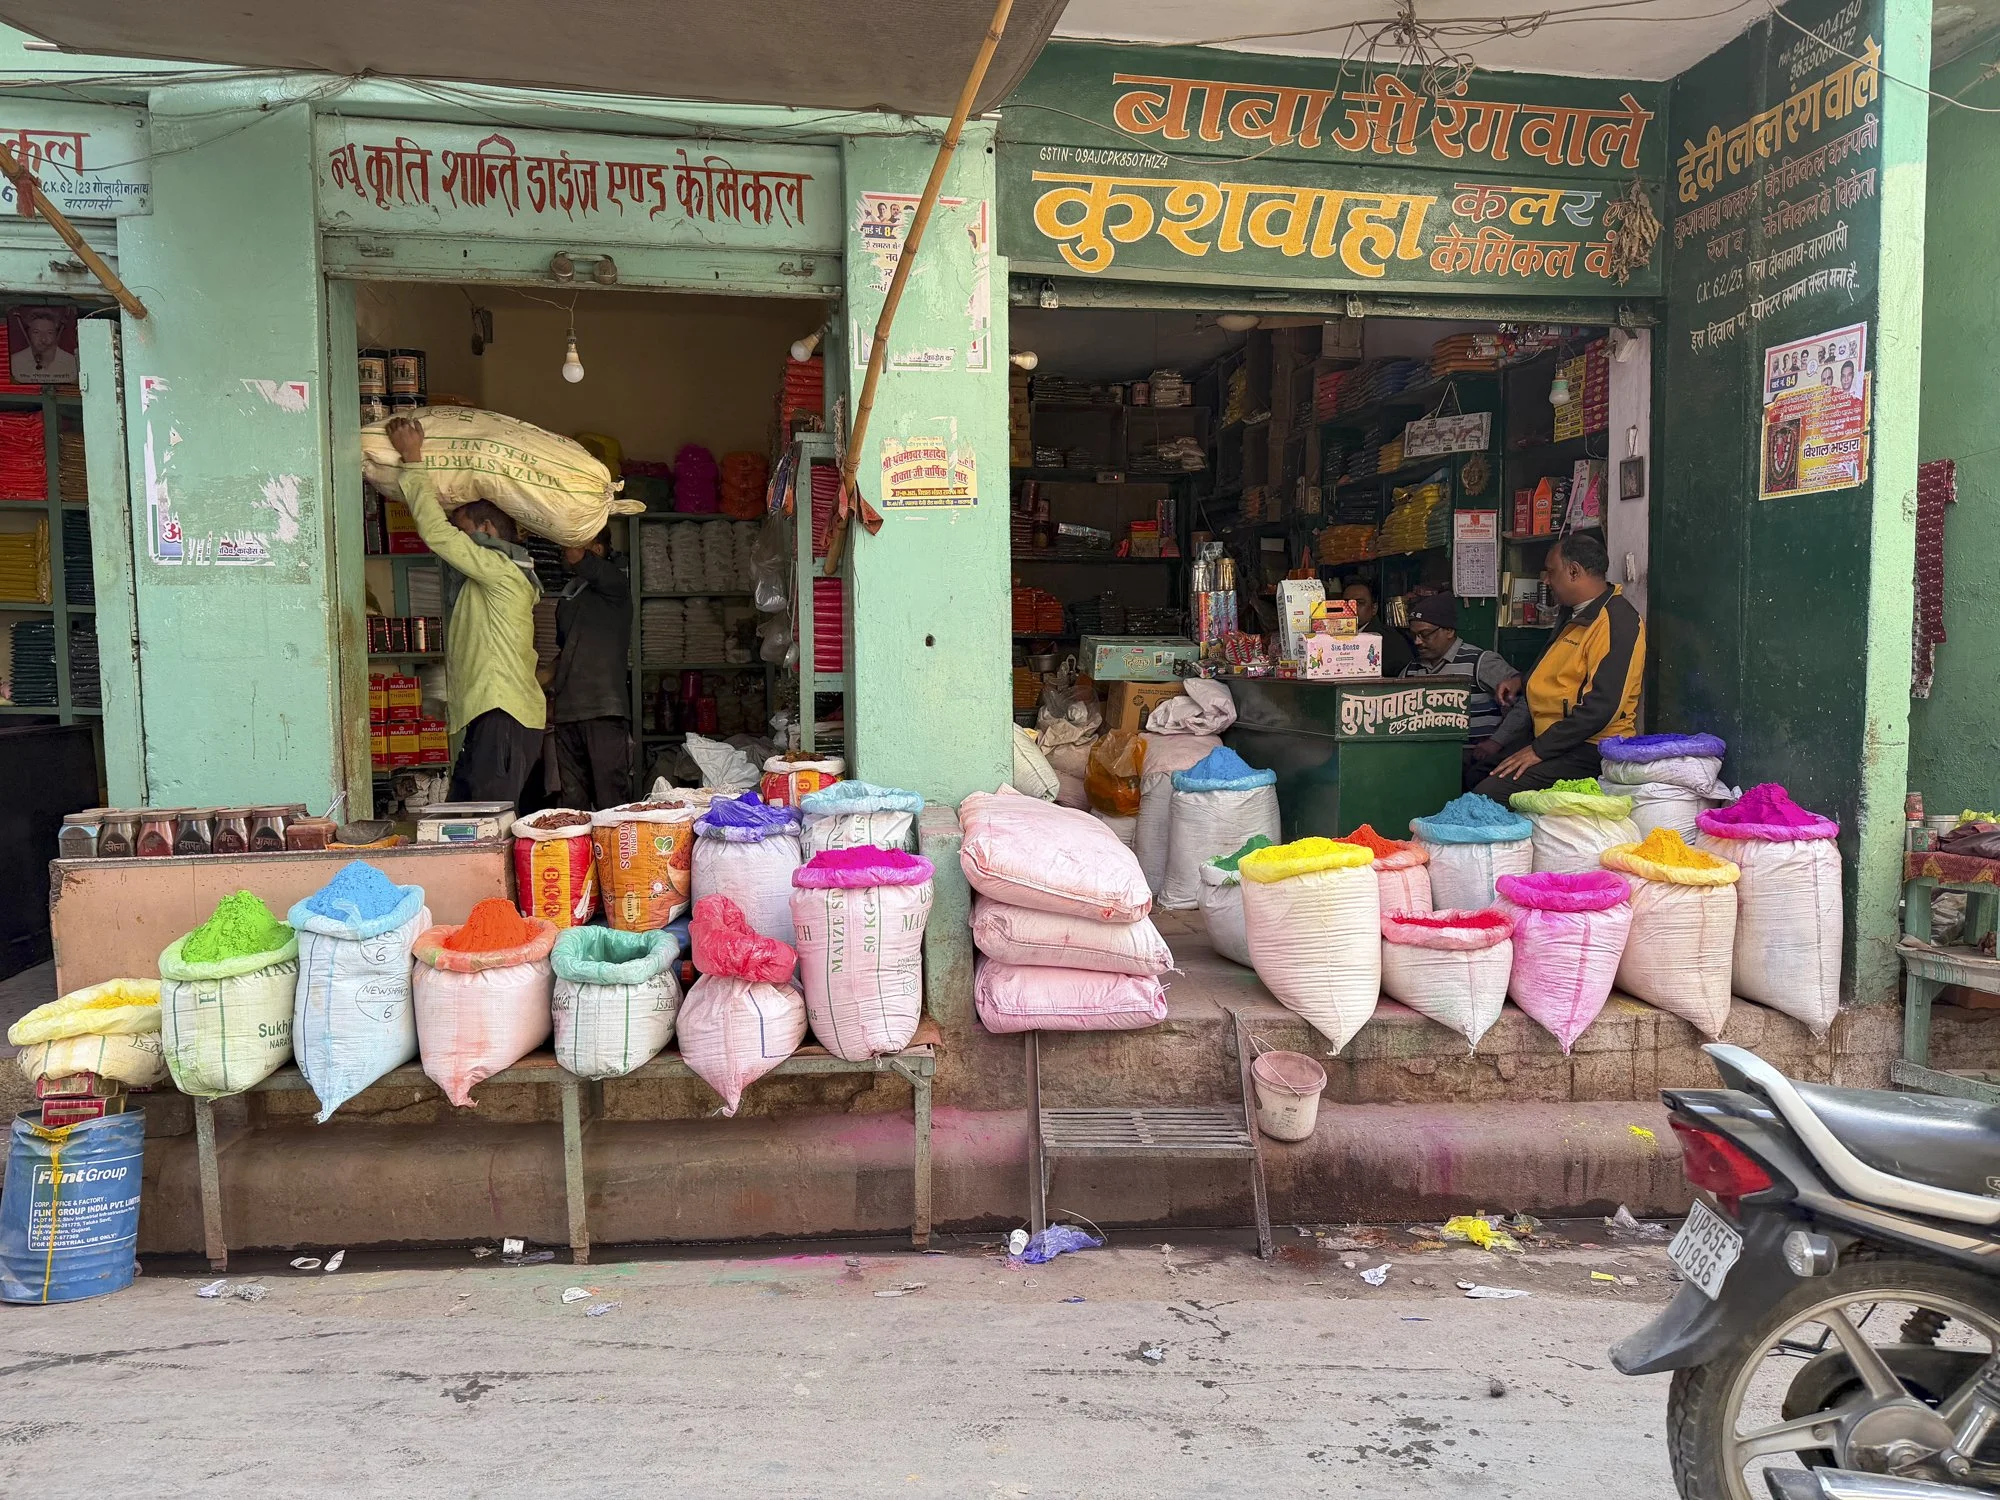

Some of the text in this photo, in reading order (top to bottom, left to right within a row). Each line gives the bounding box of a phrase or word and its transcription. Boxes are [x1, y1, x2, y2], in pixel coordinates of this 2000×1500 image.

[1823, 34, 1882, 121] वाले
[1112, 72, 1655, 169] बाबा जी रंग वाले
[673, 148, 815, 229] केमिकल
[1031, 169, 1602, 278] कुशवाहा कलर
[1430, 224, 1580, 278] केमिकल
[1690, 329, 1705, 355] इस
[424, 455, 560, 488] MAIZE STARCH
[448, 440, 539, 466] 50 KG NET
[1803, 444, 1829, 459] विशाल
[1341, 688, 1470, 735] कुशवाहा कलर
[1407, 708, 1457, 732] केमिकल
[831, 915, 845, 974] MAIZE
[864, 903, 877, 954] 50 KG
[57, 1206, 86, 1216] GROUP
[87, 1203, 108, 1213] INDIA
[1690, 1209, 1732, 1260] UP65E
[1675, 1235, 1716, 1286] D1996
